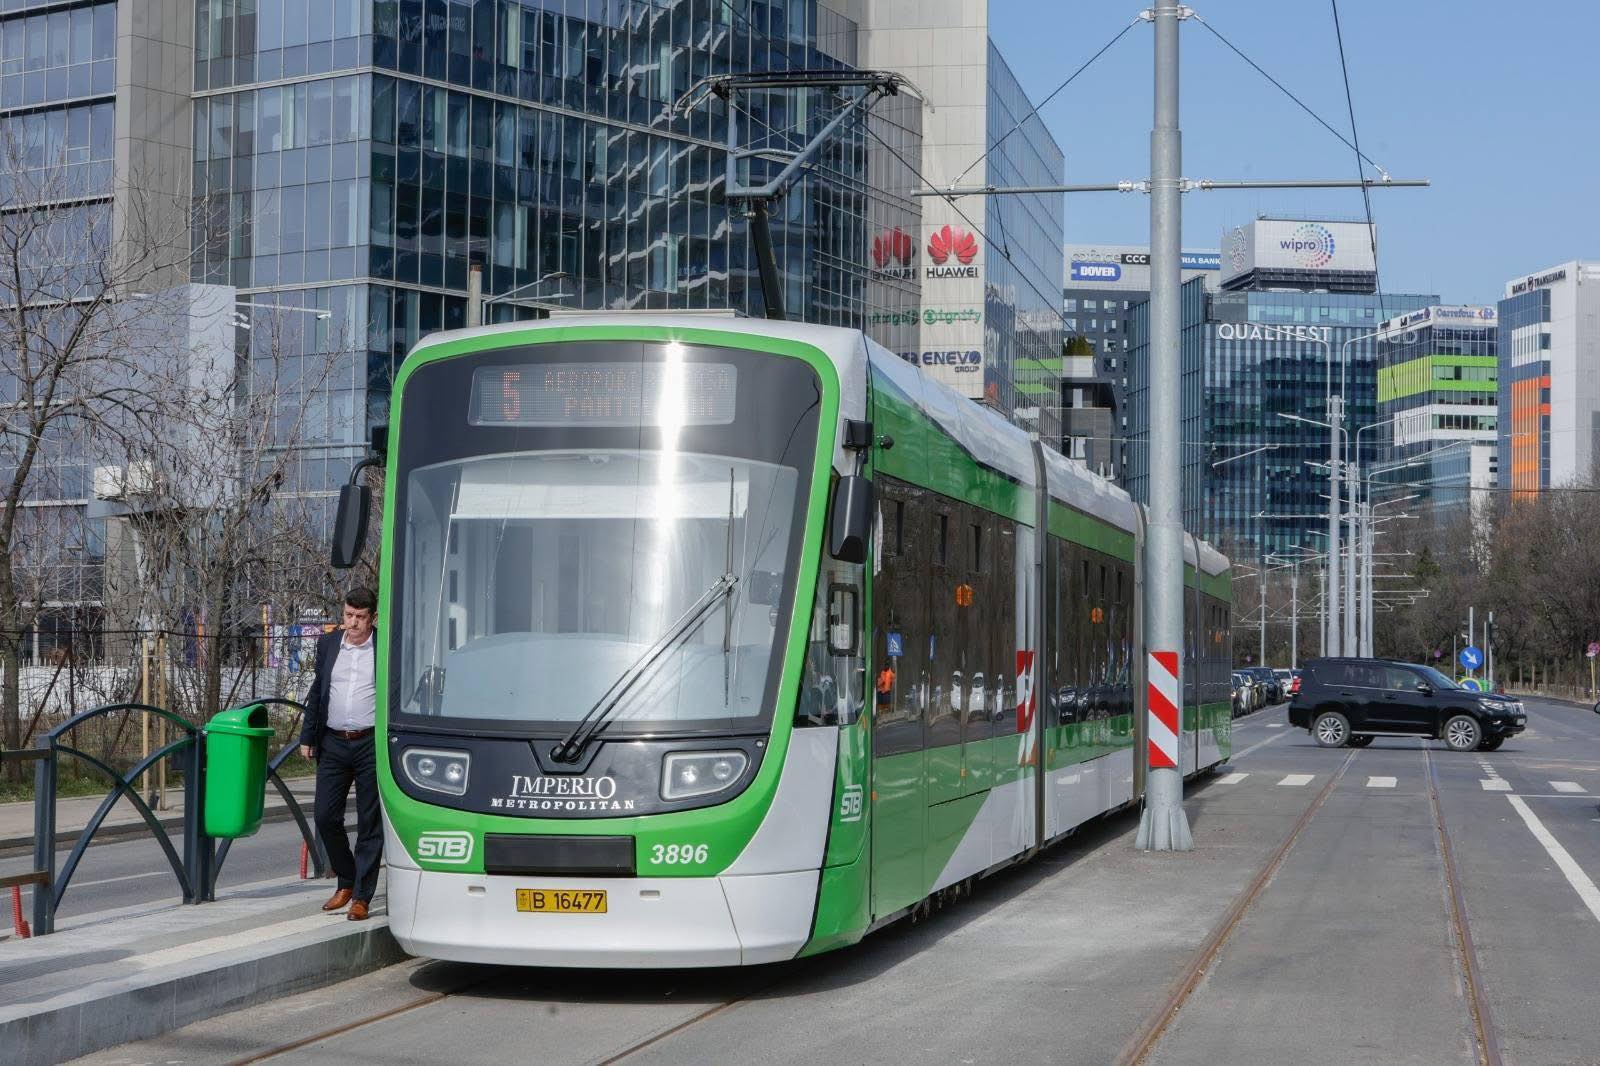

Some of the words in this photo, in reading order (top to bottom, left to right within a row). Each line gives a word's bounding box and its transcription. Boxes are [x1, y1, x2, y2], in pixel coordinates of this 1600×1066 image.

[1280, 239, 1316, 252] wipro
[1126, 255, 1146, 263] CCC
[1198, 257, 1221, 265] BANK
[927, 267, 979, 278] HUAWEI
[1080, 266, 1116, 276] DOVER
[1218, 323, 1333, 341] QUALITEST
[922, 351, 982, 365] ENEVO
[503, 371, 520, 420] 5
[509, 776, 616, 799] IMPERIO
[490, 798, 636, 810] METROPOLITAN
[841, 789, 862, 819] STB
[417, 834, 470, 860] STB
[650, 844, 709, 865] 3896
[533, 892, 546, 910] B
[555, 892, 604, 910] 16477
